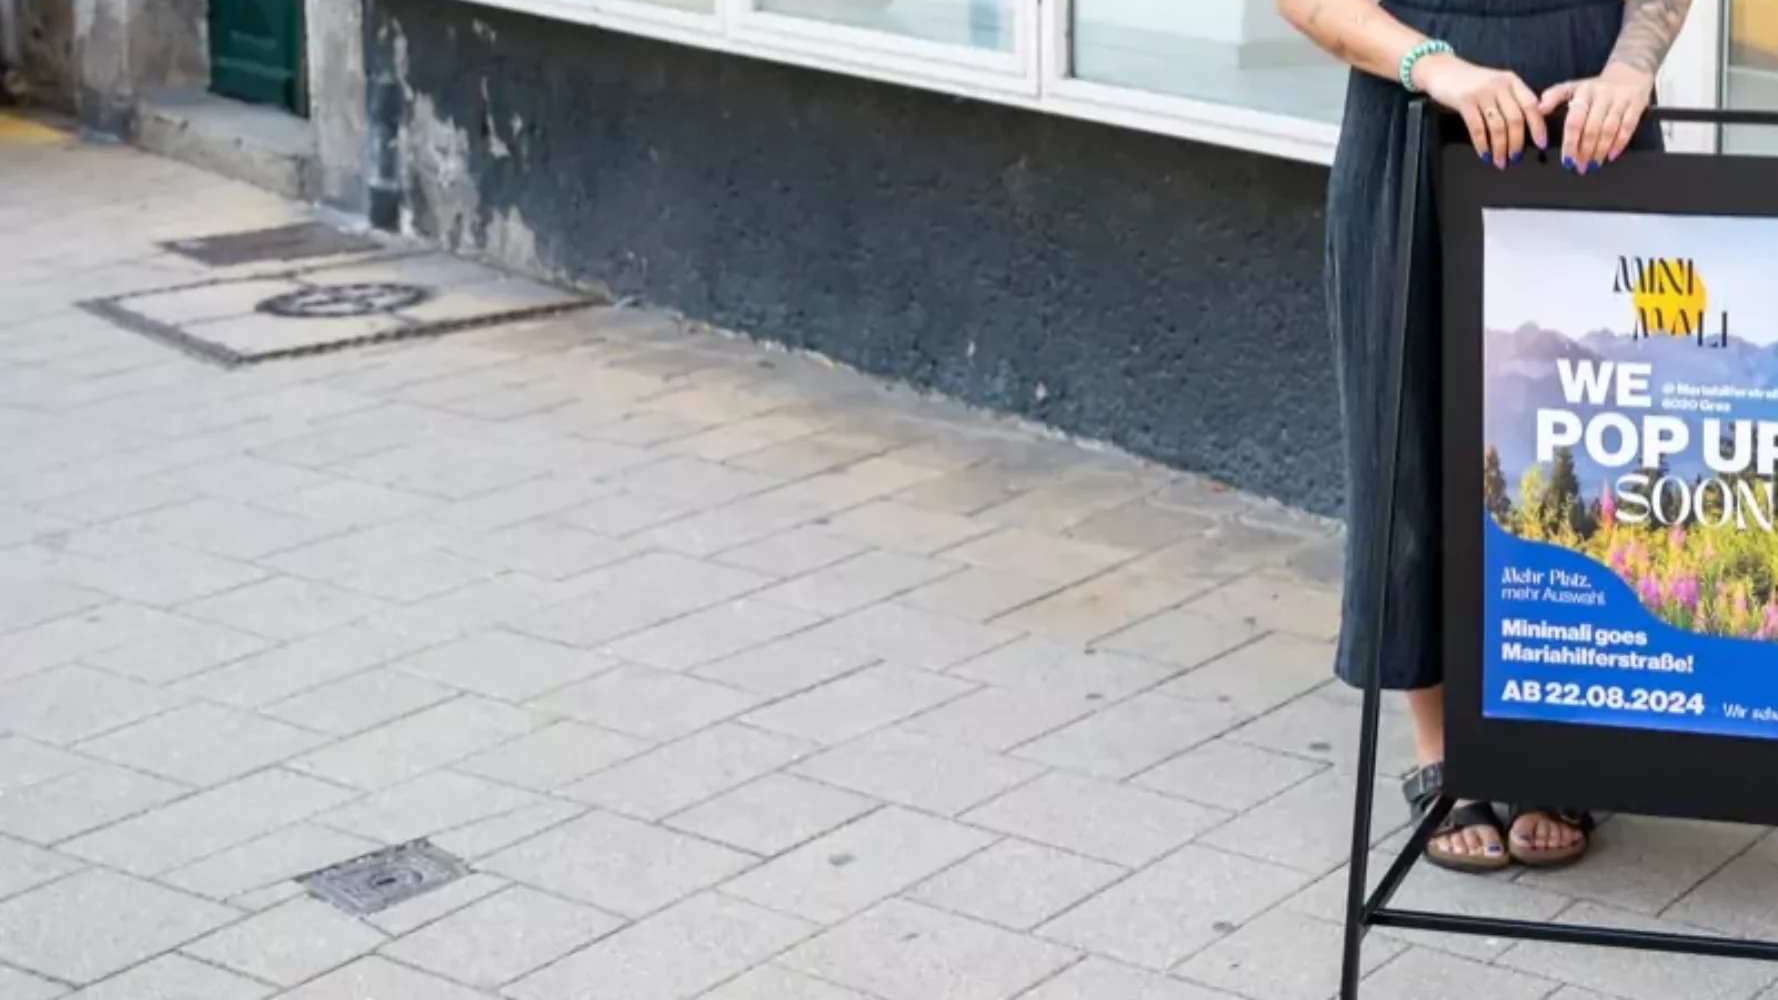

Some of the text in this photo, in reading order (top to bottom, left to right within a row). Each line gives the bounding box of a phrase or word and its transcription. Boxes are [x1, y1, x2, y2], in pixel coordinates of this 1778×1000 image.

[1613, 255, 1694, 296] MINI
[1556, 358, 1652, 408] WE
[1700, 399, 1732, 413] Graz
[1536, 407, 1690, 469] POP
[1615, 473, 1774, 532] SOON
[1501, 567, 1545, 586] Mehr
[1501, 587, 1540, 601] mehr
[1501, 618, 1648, 647] Minimali goes
[1501, 642, 1694, 674] Mariahilferstraße!
[1501, 679, 1705, 716] AB 22.08.2024
[1722, 702, 1748, 720] Wir
